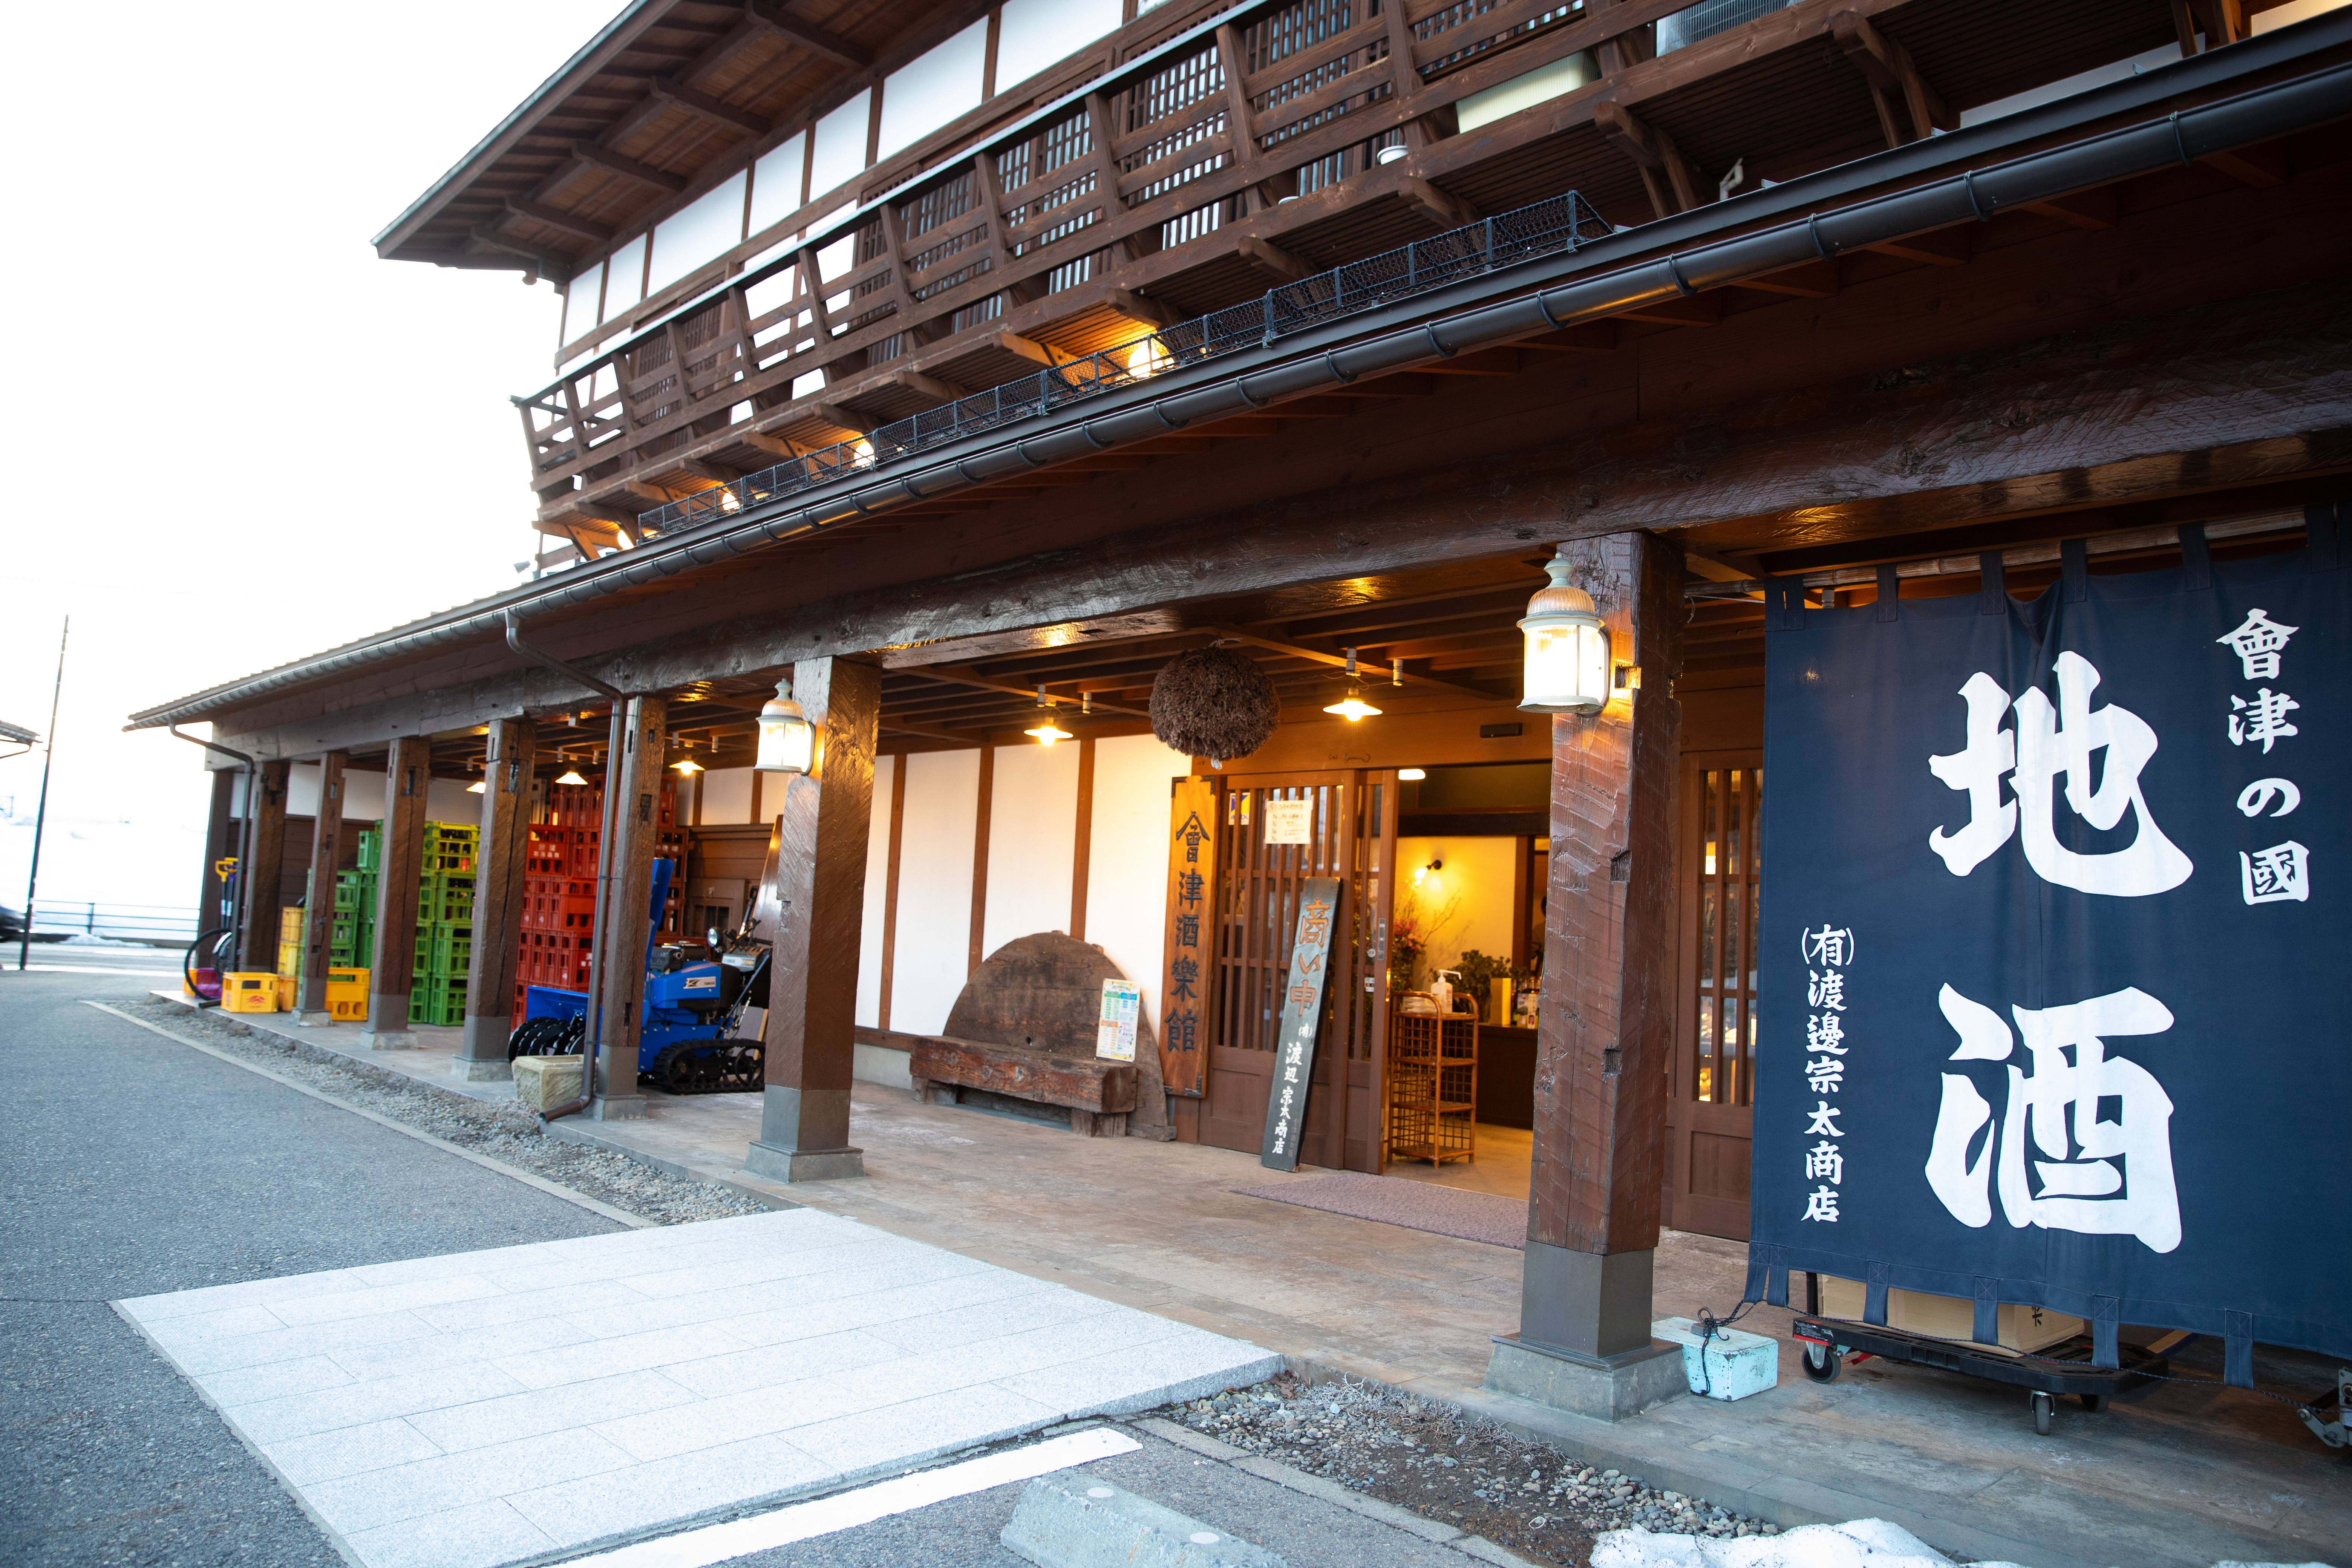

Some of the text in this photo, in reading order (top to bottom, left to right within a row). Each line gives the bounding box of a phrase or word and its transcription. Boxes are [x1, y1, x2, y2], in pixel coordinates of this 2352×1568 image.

[2216, 608, 2309, 905] 會津の國
[1164, 811, 1210, 1052] 會津酒樂館
[1290, 898, 1330, 1017] 商い中
[1925, 651, 2194, 1253] 地酒
